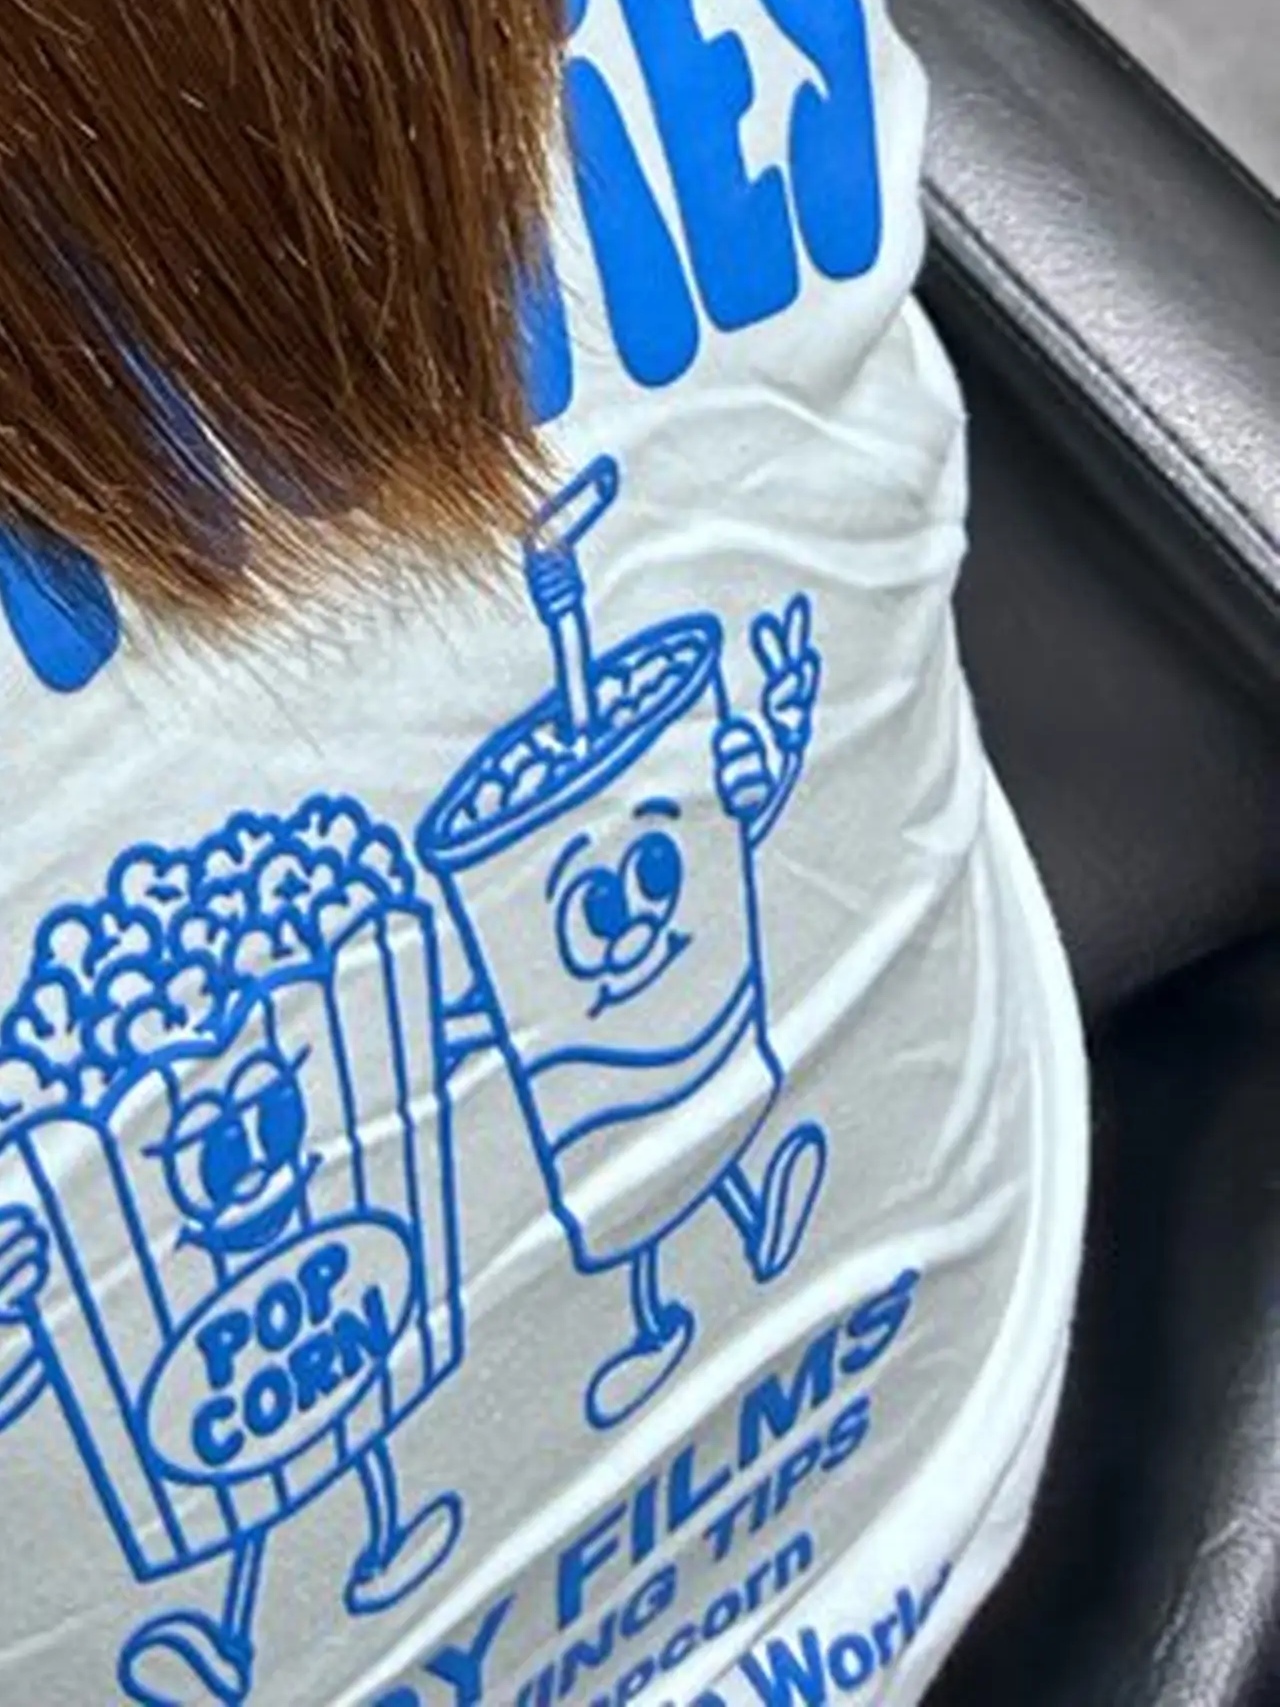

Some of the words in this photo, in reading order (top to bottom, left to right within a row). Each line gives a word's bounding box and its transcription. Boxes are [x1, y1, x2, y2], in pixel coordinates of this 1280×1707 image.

[192, 1284, 392, 1466] CORN
[194, 1242, 349, 1389] POP
[555, 1266, 921, 1630] FILMS
[702, 1392, 872, 1560] TIPS
